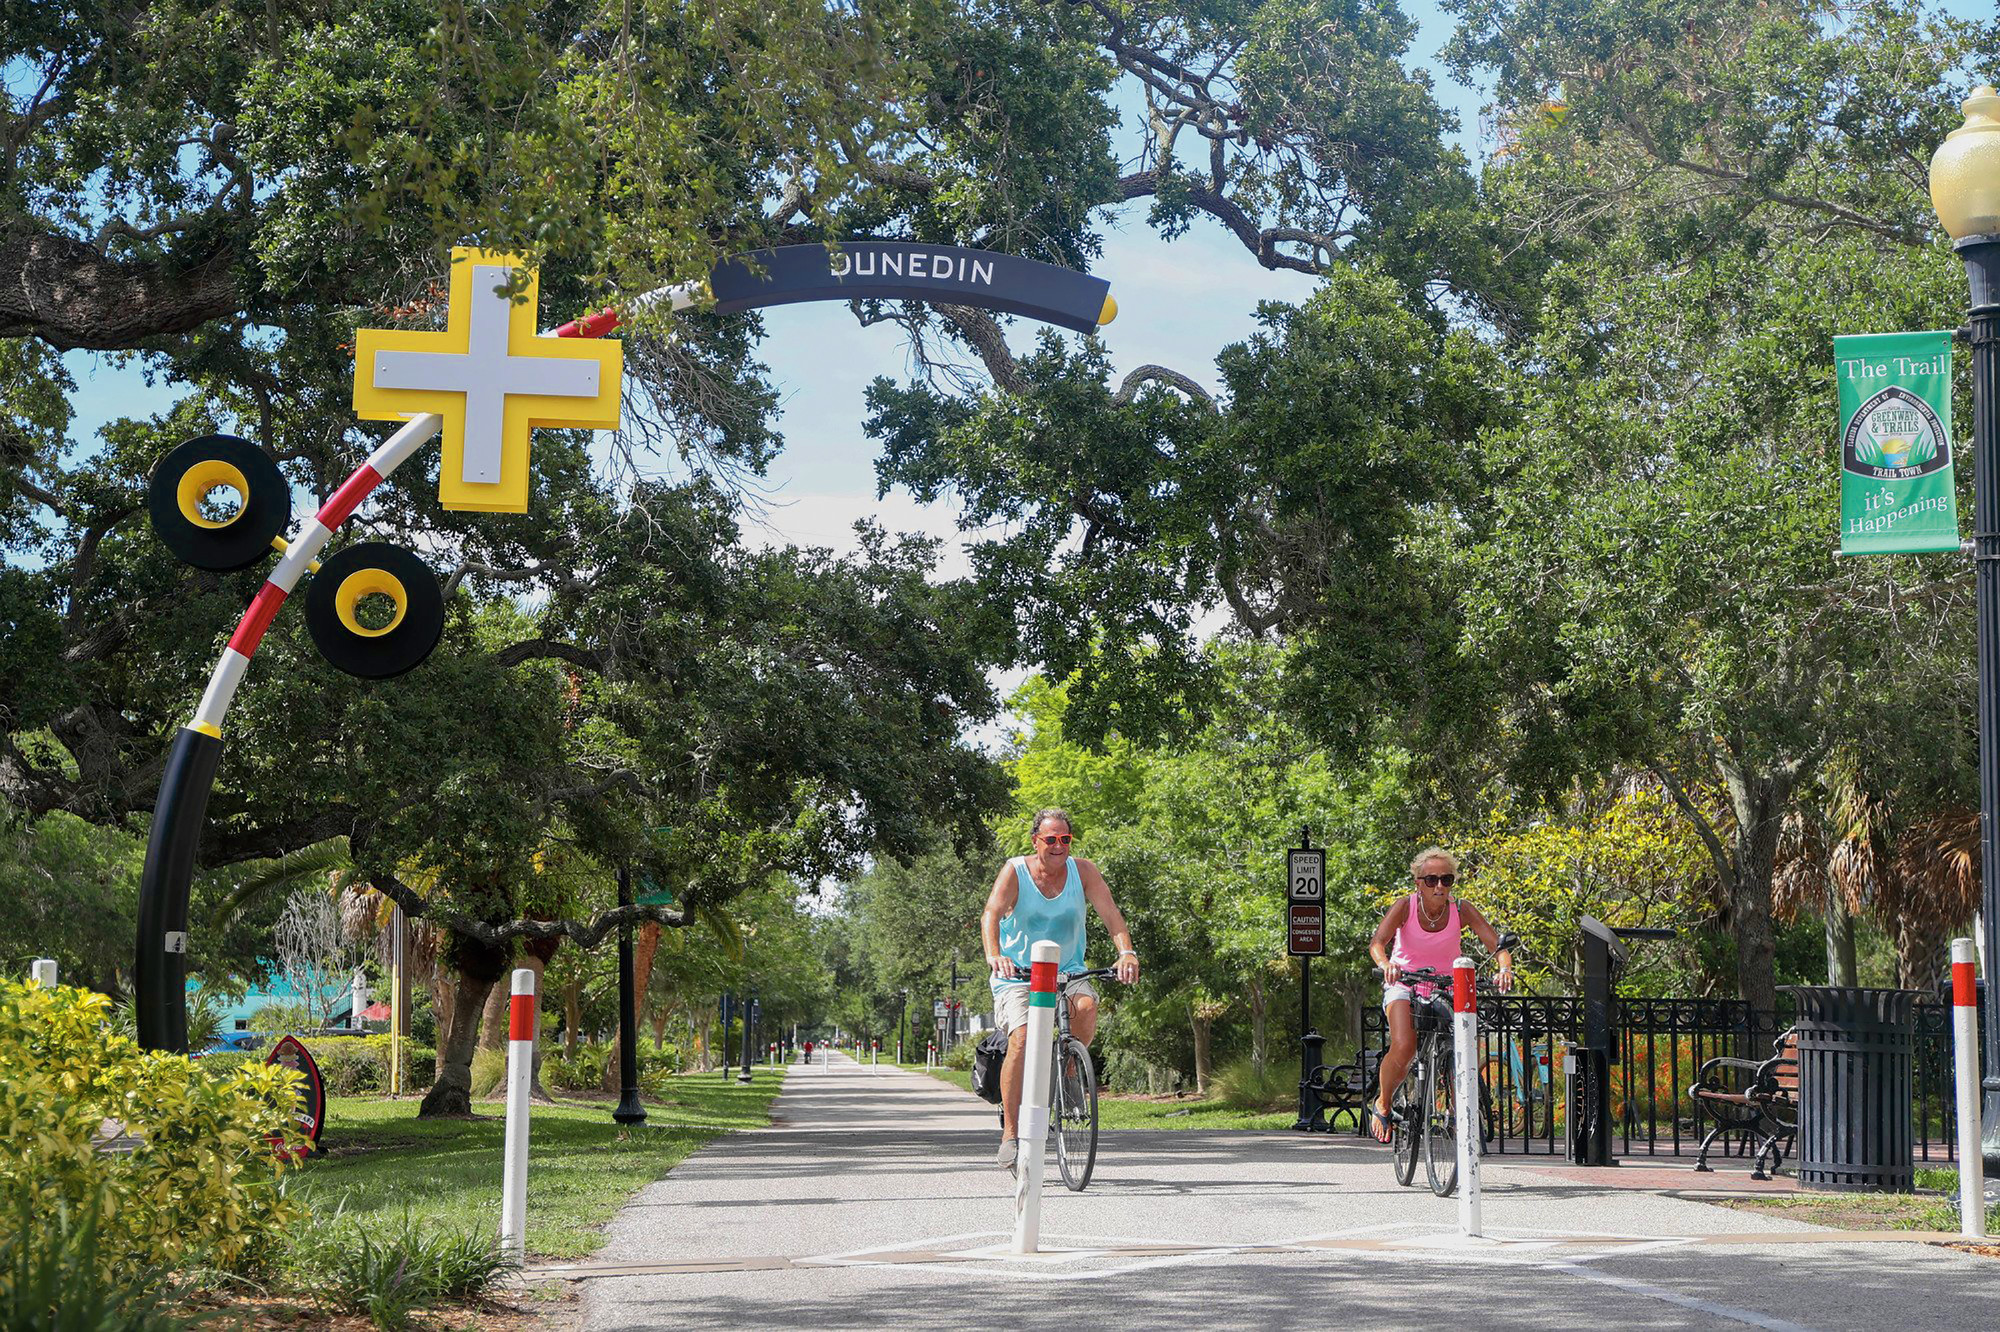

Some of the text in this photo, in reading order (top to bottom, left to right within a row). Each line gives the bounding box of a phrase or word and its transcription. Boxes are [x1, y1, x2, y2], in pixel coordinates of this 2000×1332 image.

[830, 252, 994, 285] DUNEDIN
[1841, 354, 1947, 379] The Trail
[1871, 410, 1920, 422] GREENWAYS
[1871, 421, 1920, 433] & TRAILS
[1847, 425, 1858, 447] FLORIDA
[1872, 465, 1923, 478] TRAIL TOWN
[1864, 486, 1895, 511] it's
[1849, 496, 1948, 534] Happening
[1295, 877, 1319, 895] 20
